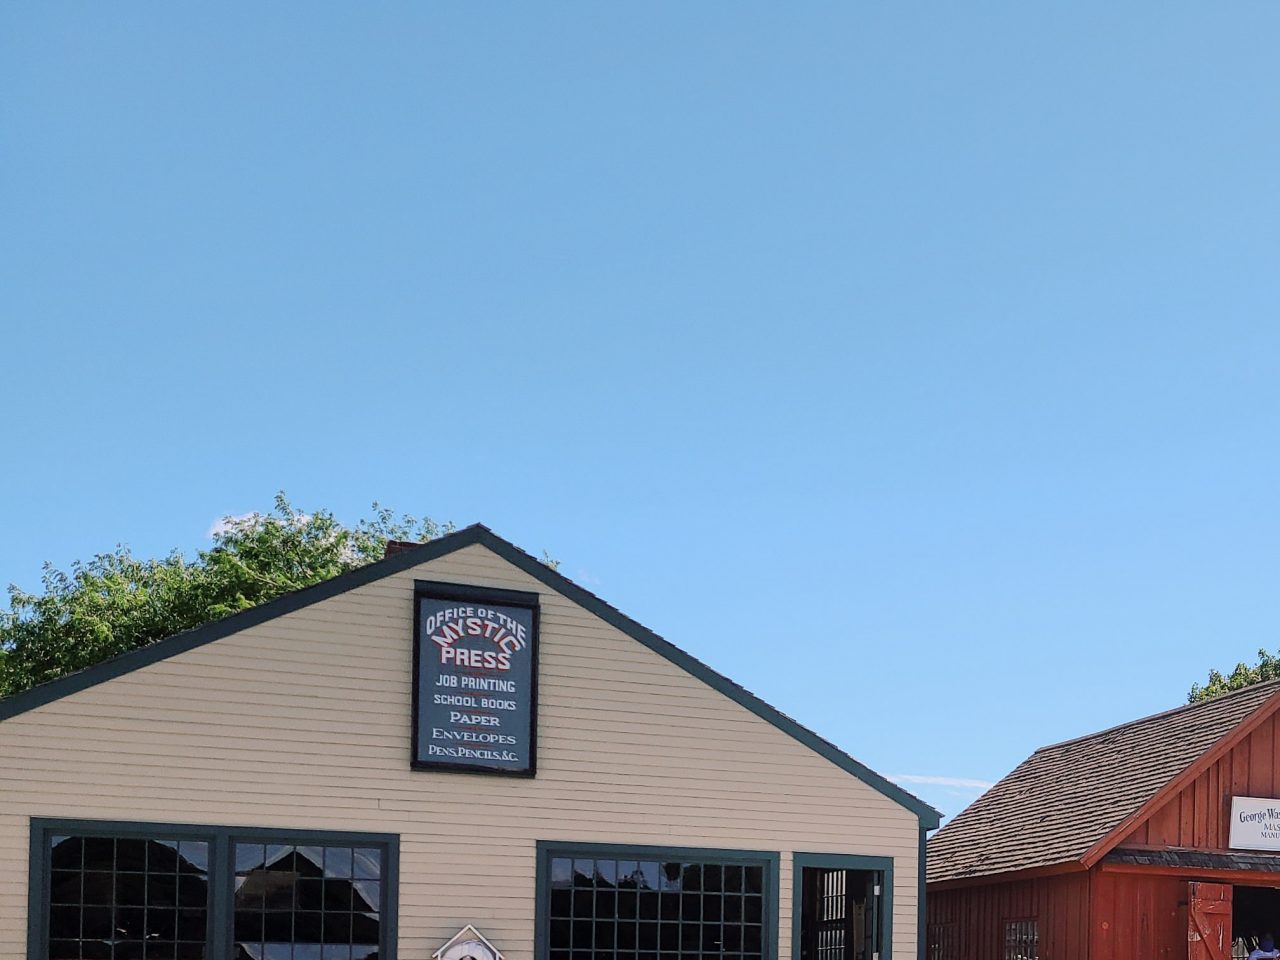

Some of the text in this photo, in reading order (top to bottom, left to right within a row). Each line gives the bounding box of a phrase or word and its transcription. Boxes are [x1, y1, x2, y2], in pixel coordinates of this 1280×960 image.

[426, 607, 526, 649] OFFICE OF THE
[431, 618, 521, 655] MYSTIC
[441, 646, 512, 670] PRESS
[436, 674, 516, 693] JOB PRINTING
[433, 694, 517, 711] SCHOOL BOOKS
[450, 711, 501, 727] PAPER
[432, 727, 517, 745] ENVELOPES
[1239, 810, 1267, 824] George
